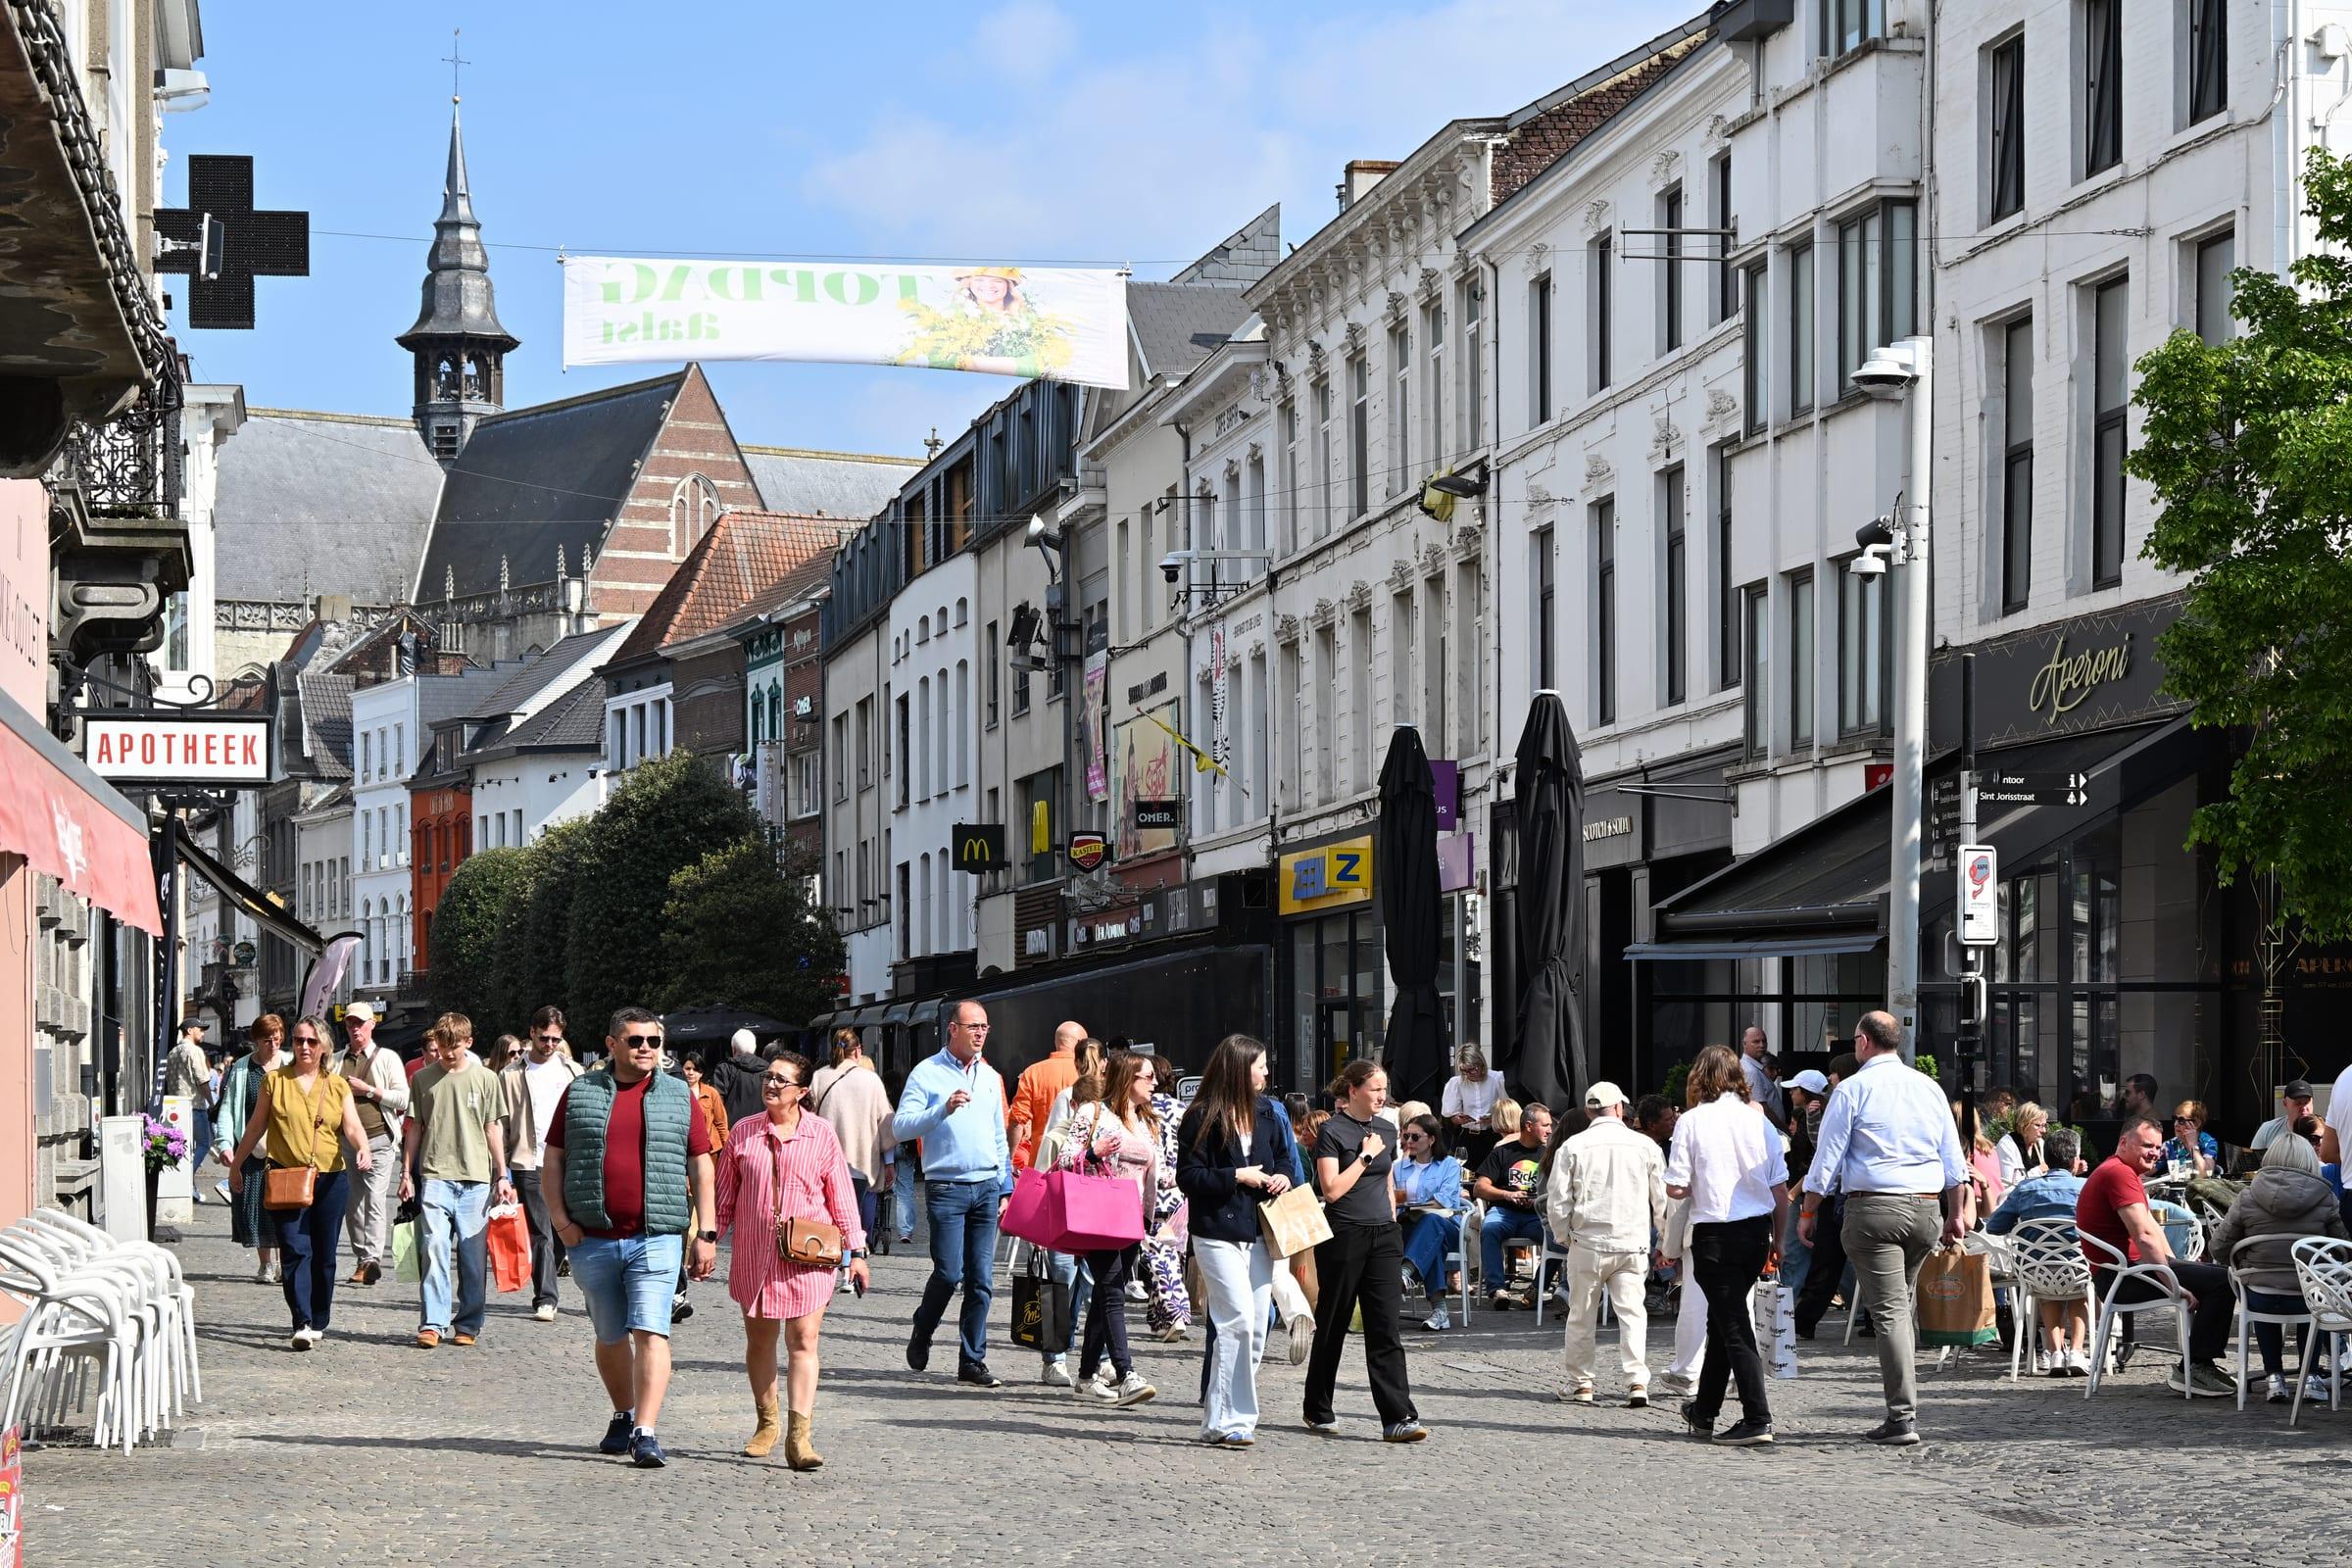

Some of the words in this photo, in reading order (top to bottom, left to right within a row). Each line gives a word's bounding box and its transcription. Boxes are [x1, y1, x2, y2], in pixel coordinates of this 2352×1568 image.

[2030, 633, 2132, 724] Aperoni
[97, 732, 257, 765] APOTHEEK
[1980, 792, 1995, 801] Sint
[1996, 792, 2035, 802] Jorisstraat
[1138, 812, 1175, 823] OMER.
[1072, 844, 1102, 857] KASTEEL
[1336, 854, 1360, 881] Z
